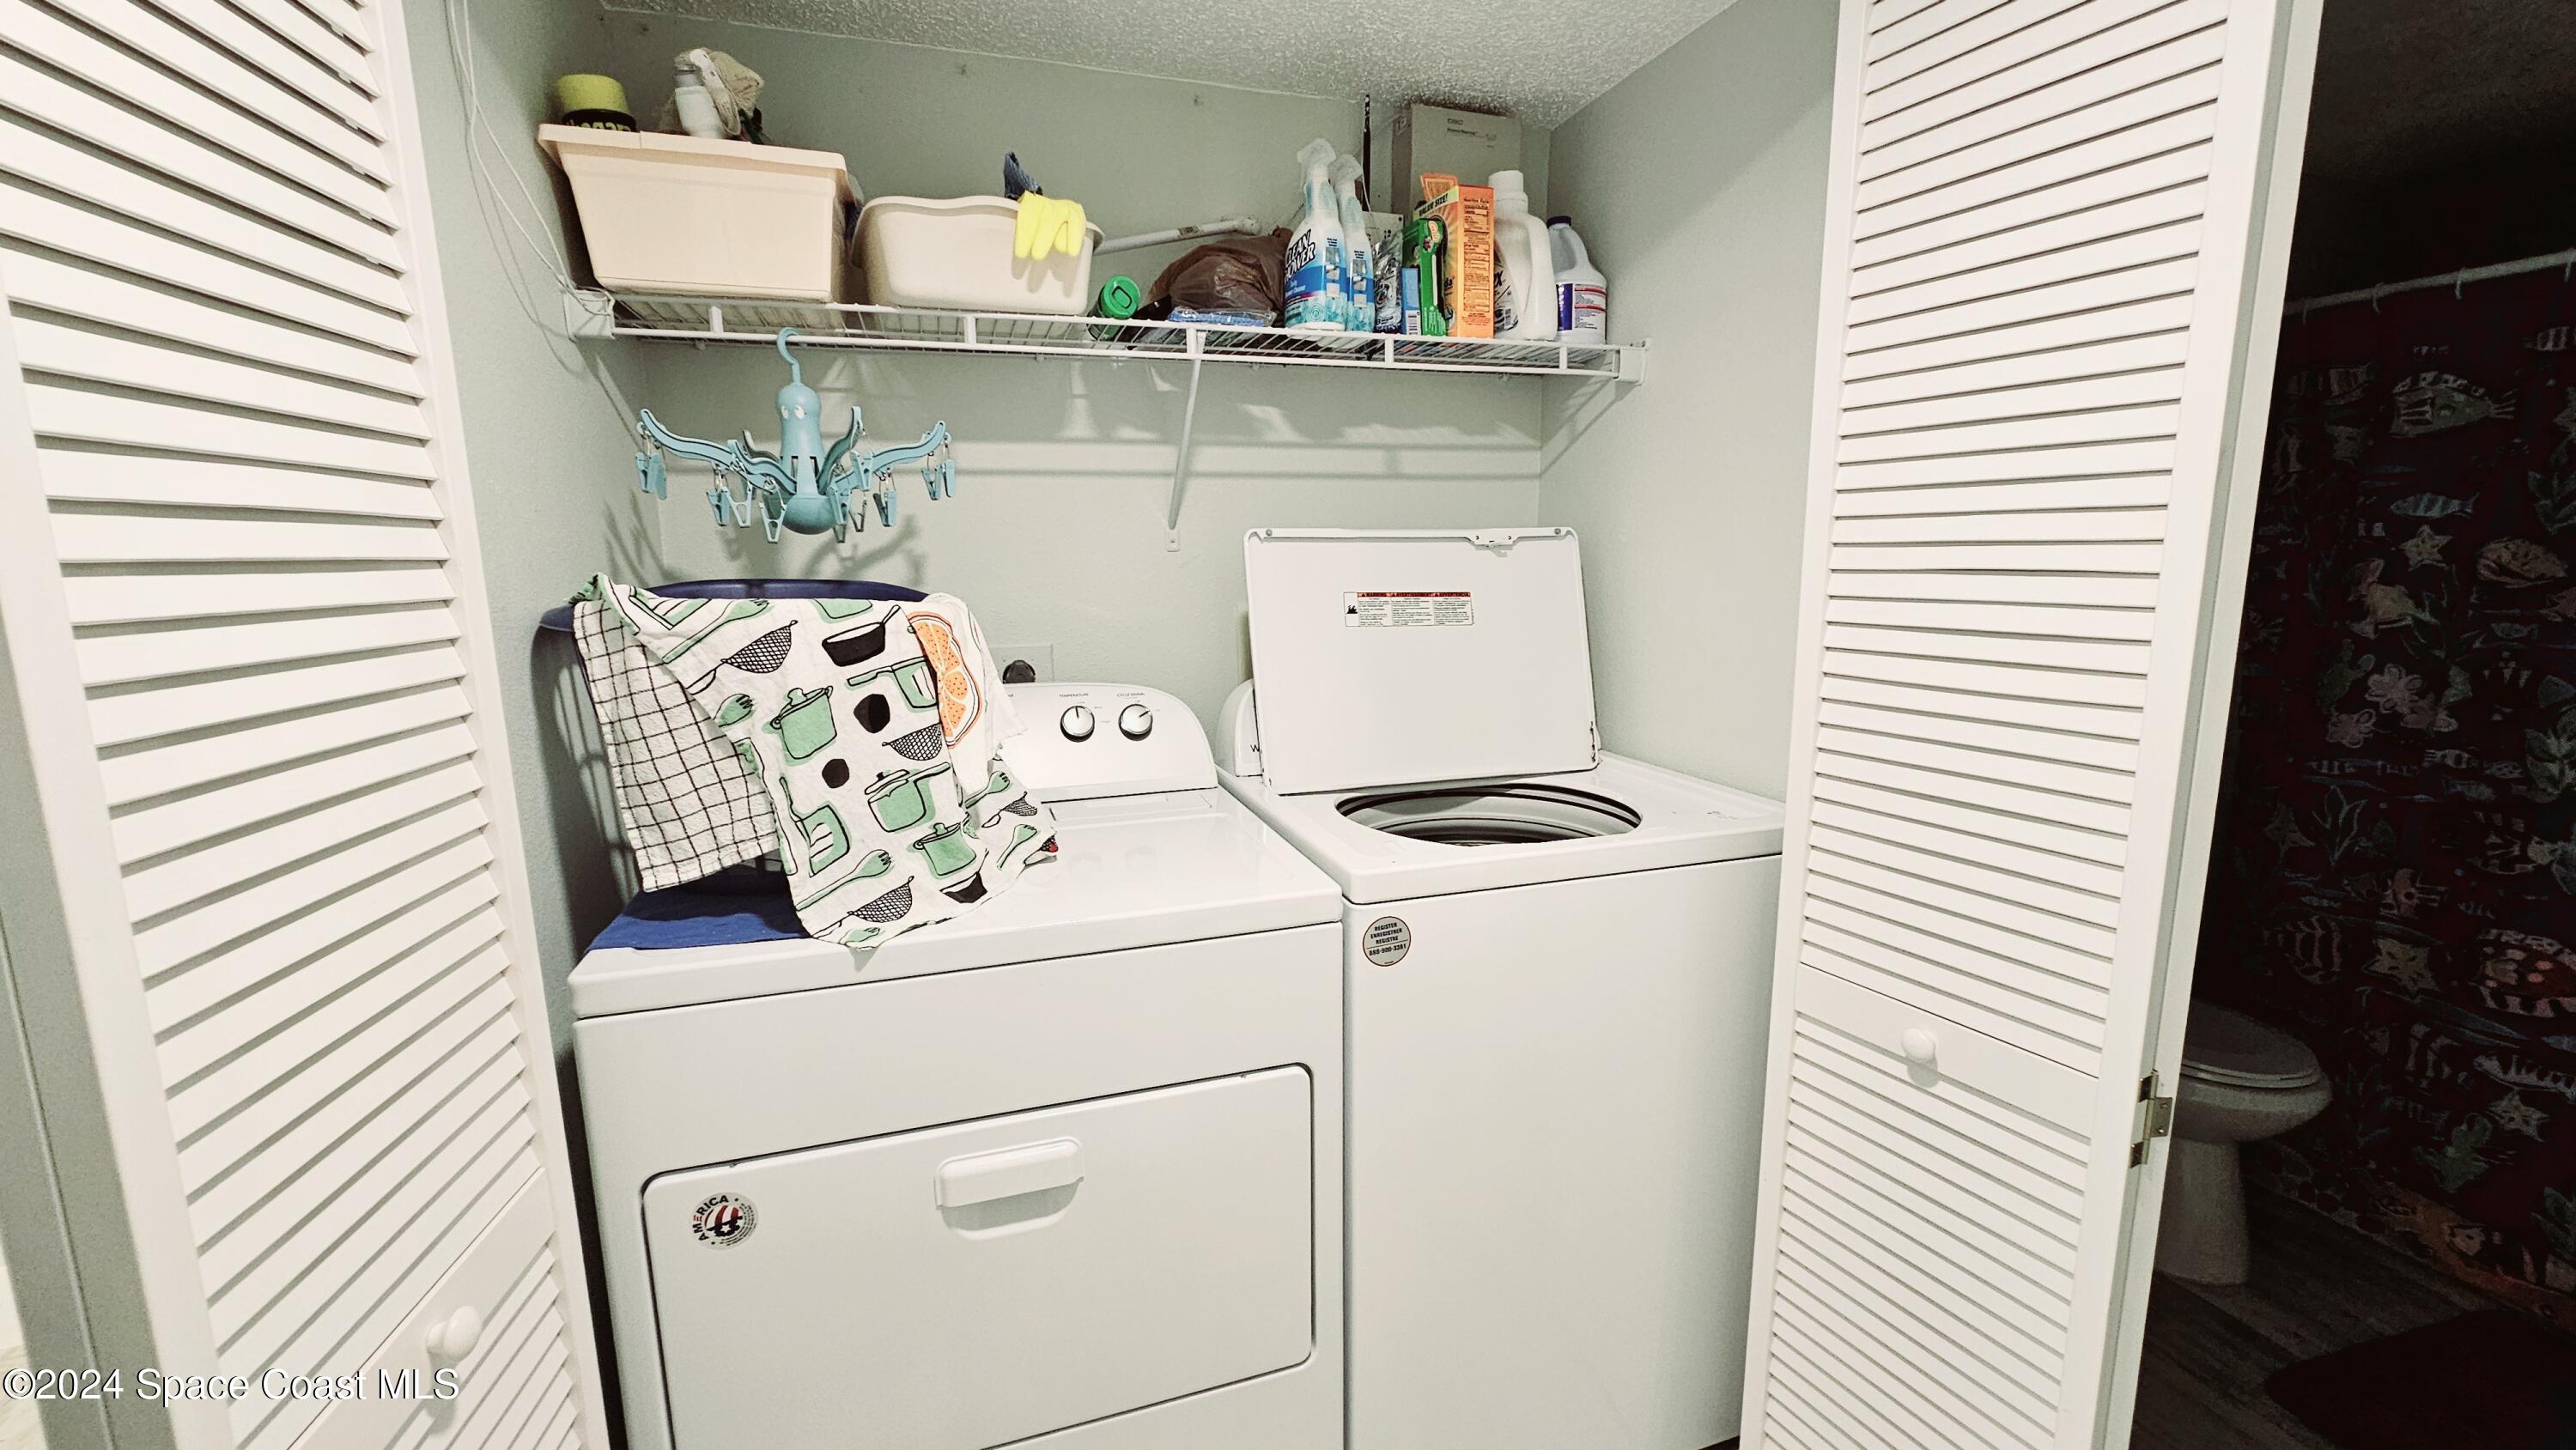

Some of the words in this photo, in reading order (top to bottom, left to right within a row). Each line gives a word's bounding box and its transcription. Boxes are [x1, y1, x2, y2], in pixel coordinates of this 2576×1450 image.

[1285, 241, 1316, 281] OWER
[1375, 922, 1397, 931] REGISTER
[692, 1195, 729, 1241] AMERICA
